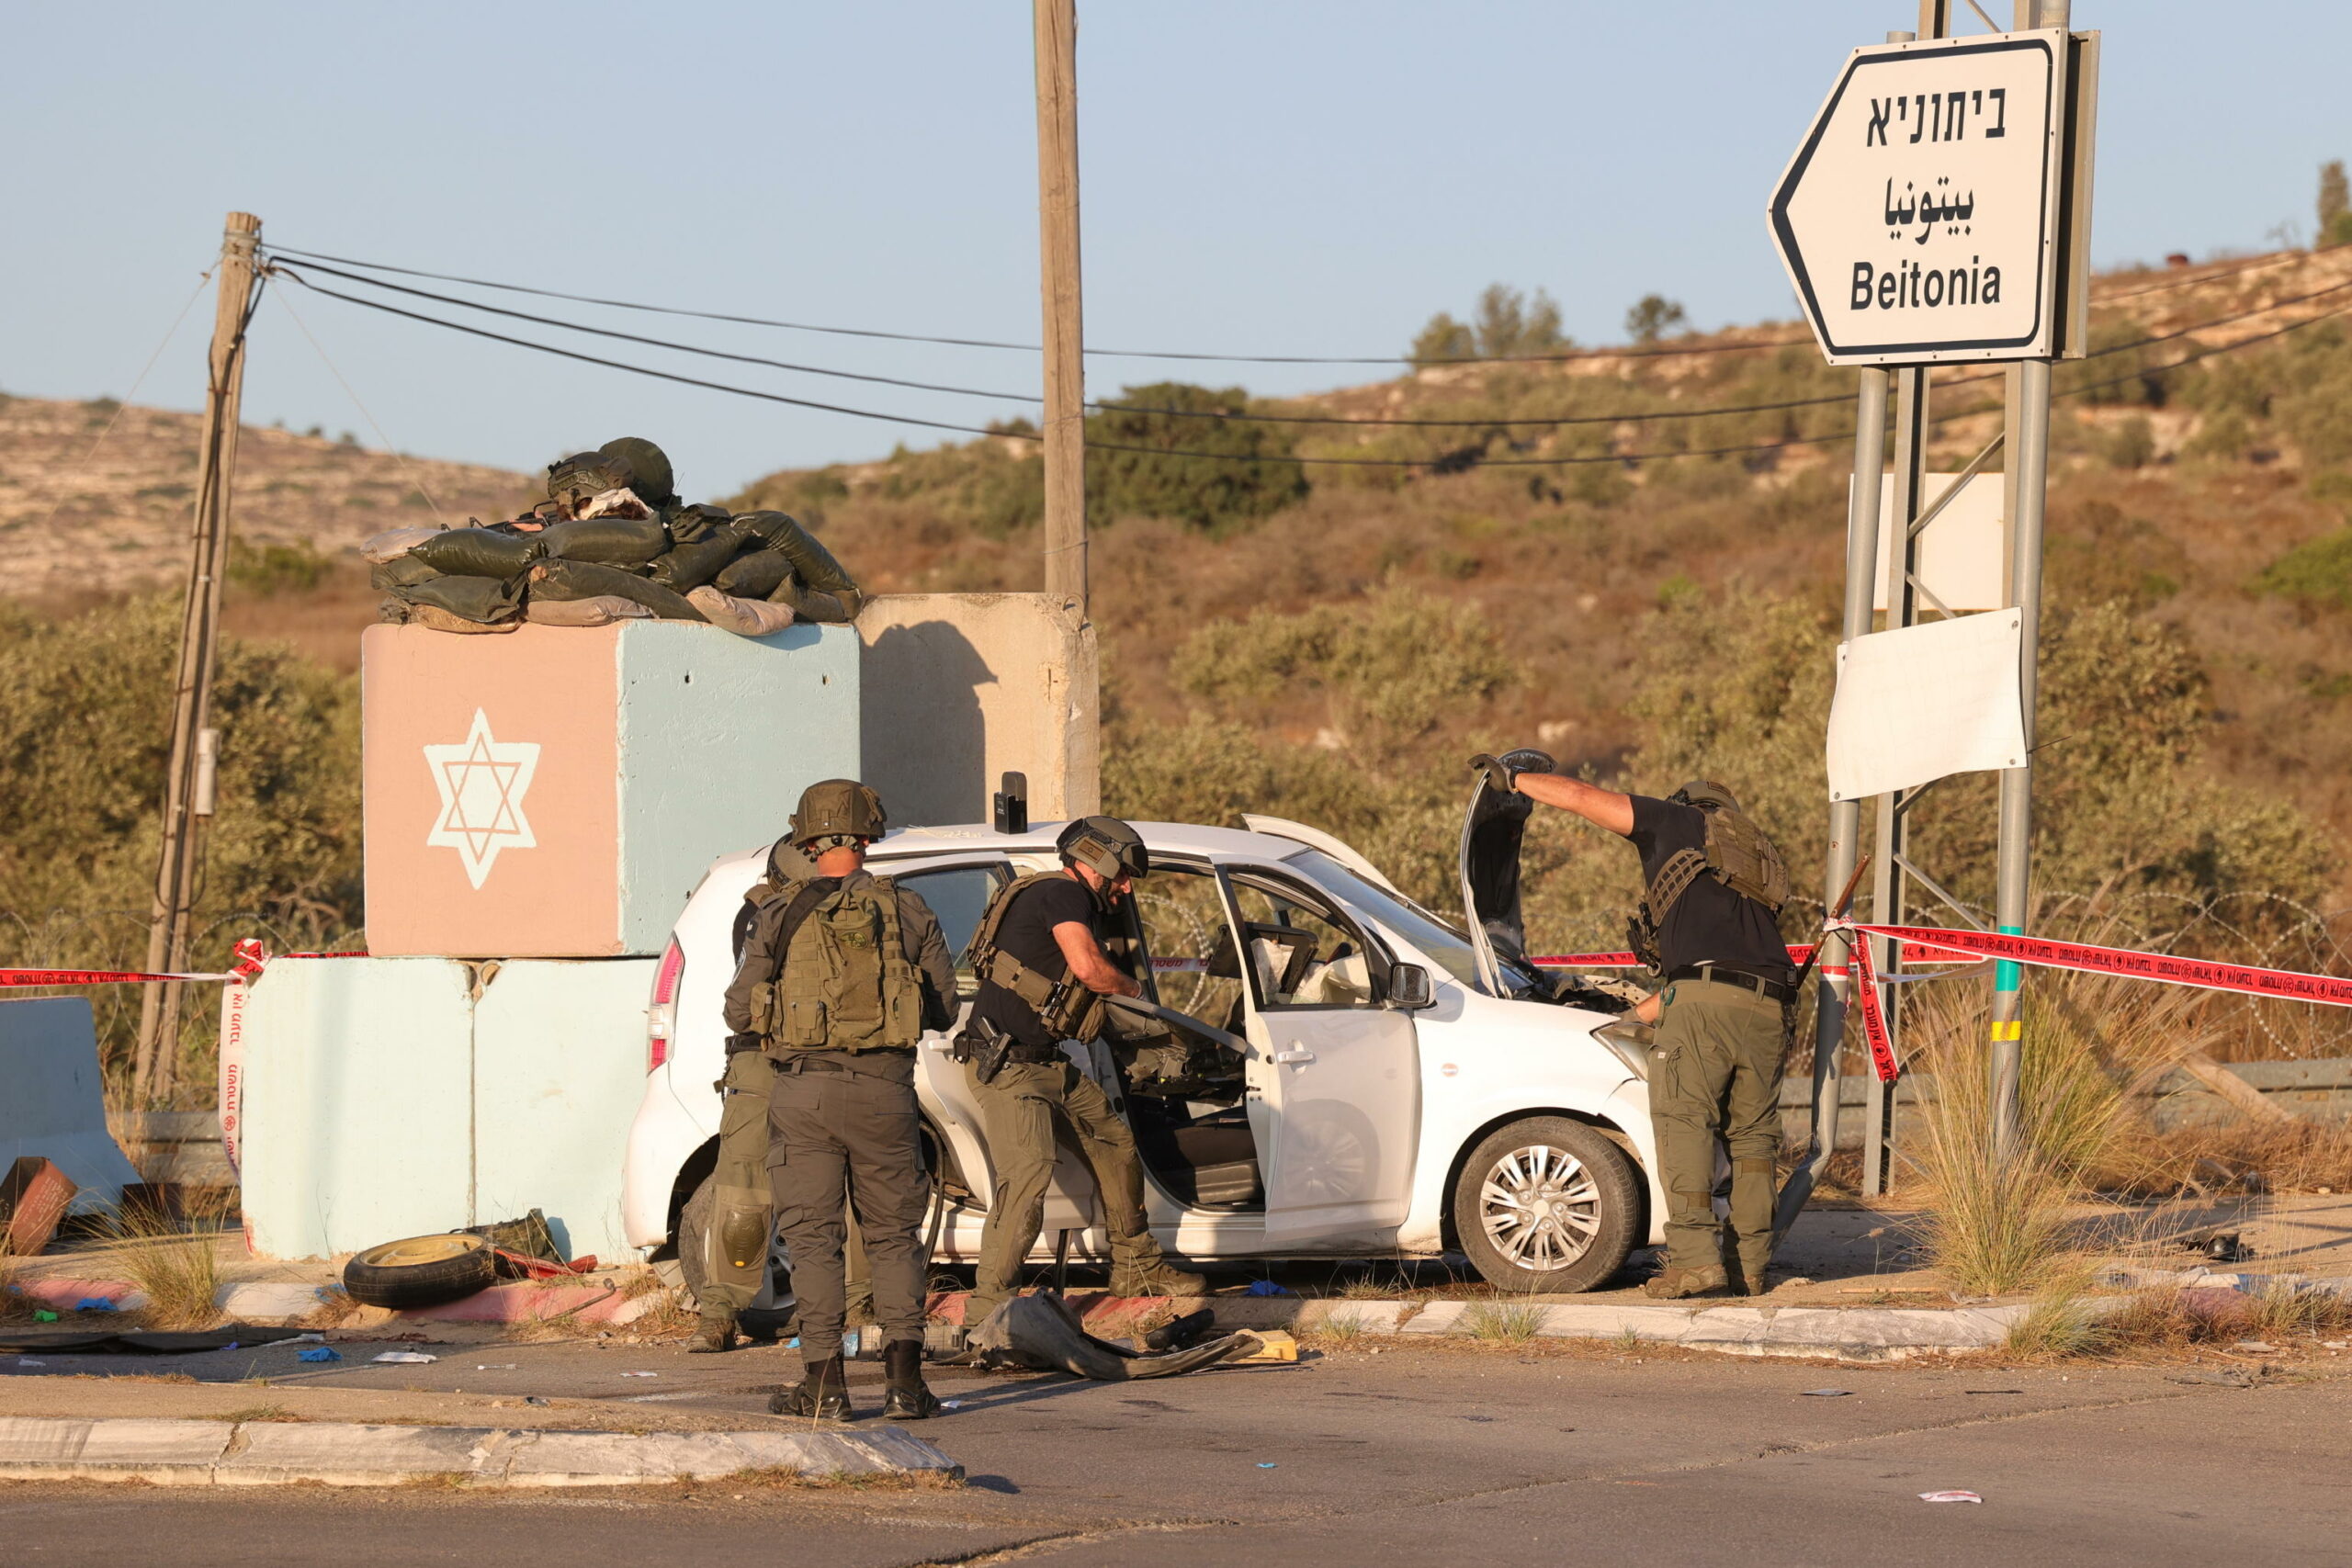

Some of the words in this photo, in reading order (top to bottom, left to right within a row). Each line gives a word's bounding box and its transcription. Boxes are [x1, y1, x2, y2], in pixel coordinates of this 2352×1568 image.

[1866, 87, 2006, 147] ביתוניא
[1884, 175, 1974, 245] بيتونيا
[1850, 255, 2001, 310] Beitonia
[232, 993, 243, 1009] אין
[1865, 1003, 1879, 1029] מעבר
[230, 1013, 242, 1045] מעבר
[227, 1064, 237, 1111] משטרת
